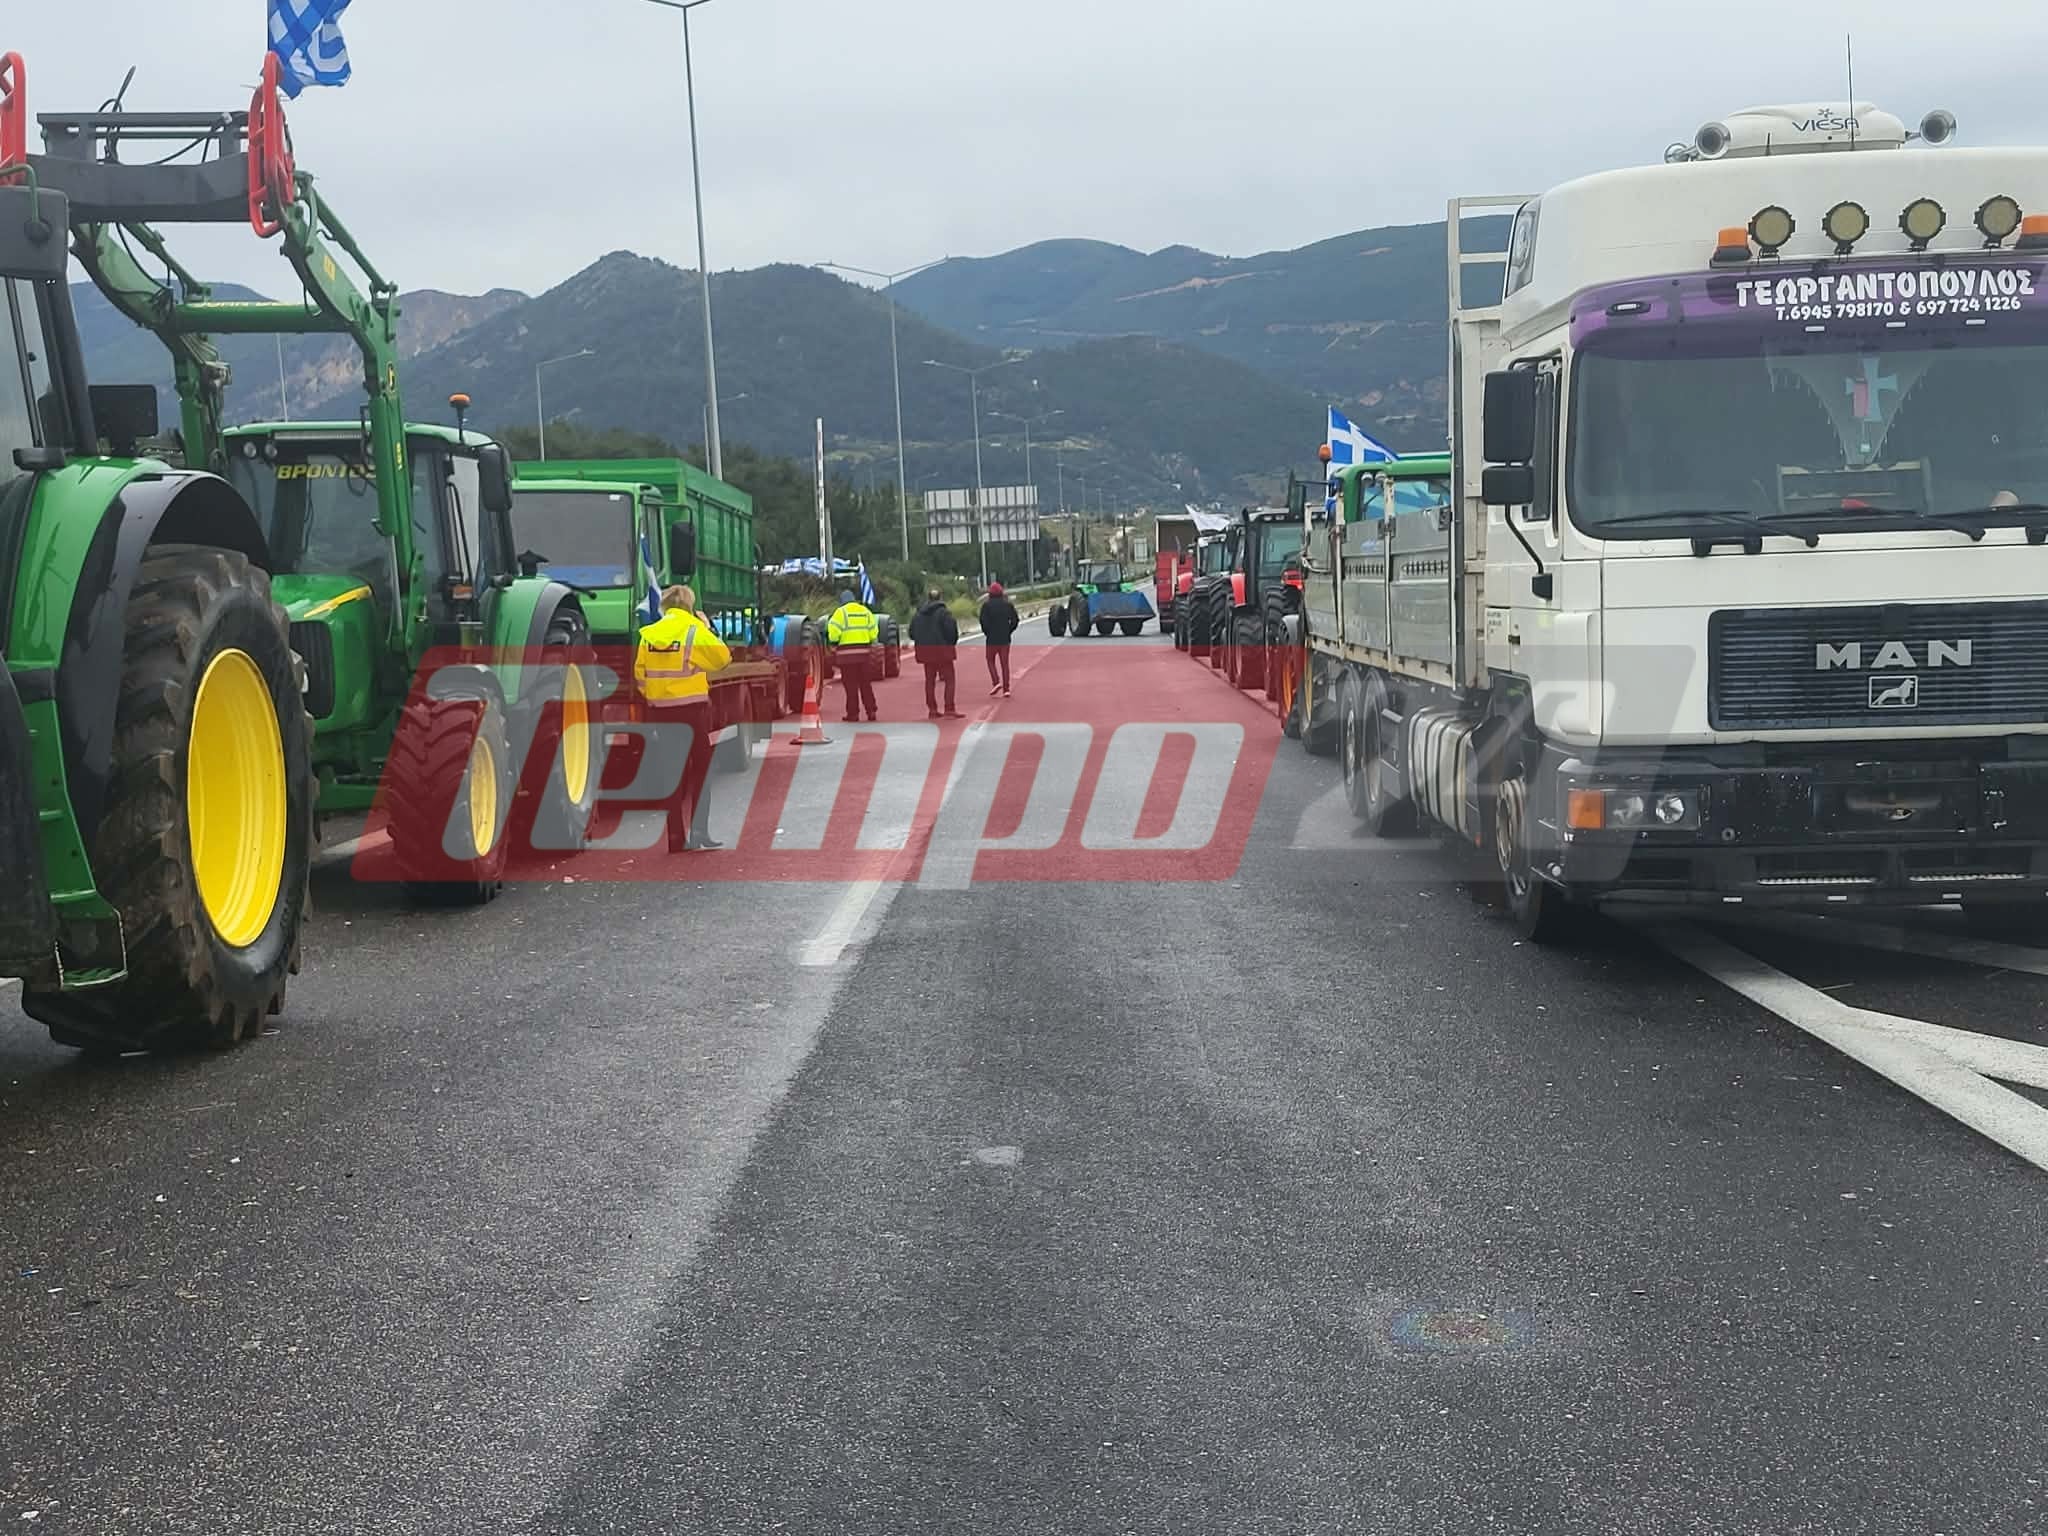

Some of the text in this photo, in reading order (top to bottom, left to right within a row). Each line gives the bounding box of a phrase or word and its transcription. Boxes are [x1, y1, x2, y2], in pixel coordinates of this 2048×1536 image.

[1792, 117, 1860, 132] VIESA
[1835, 301, 1894, 318] 798170
[1899, 301, 1911, 316] &
[1984, 296, 2021, 311] 1226
[1815, 639, 1972, 670] MAN
